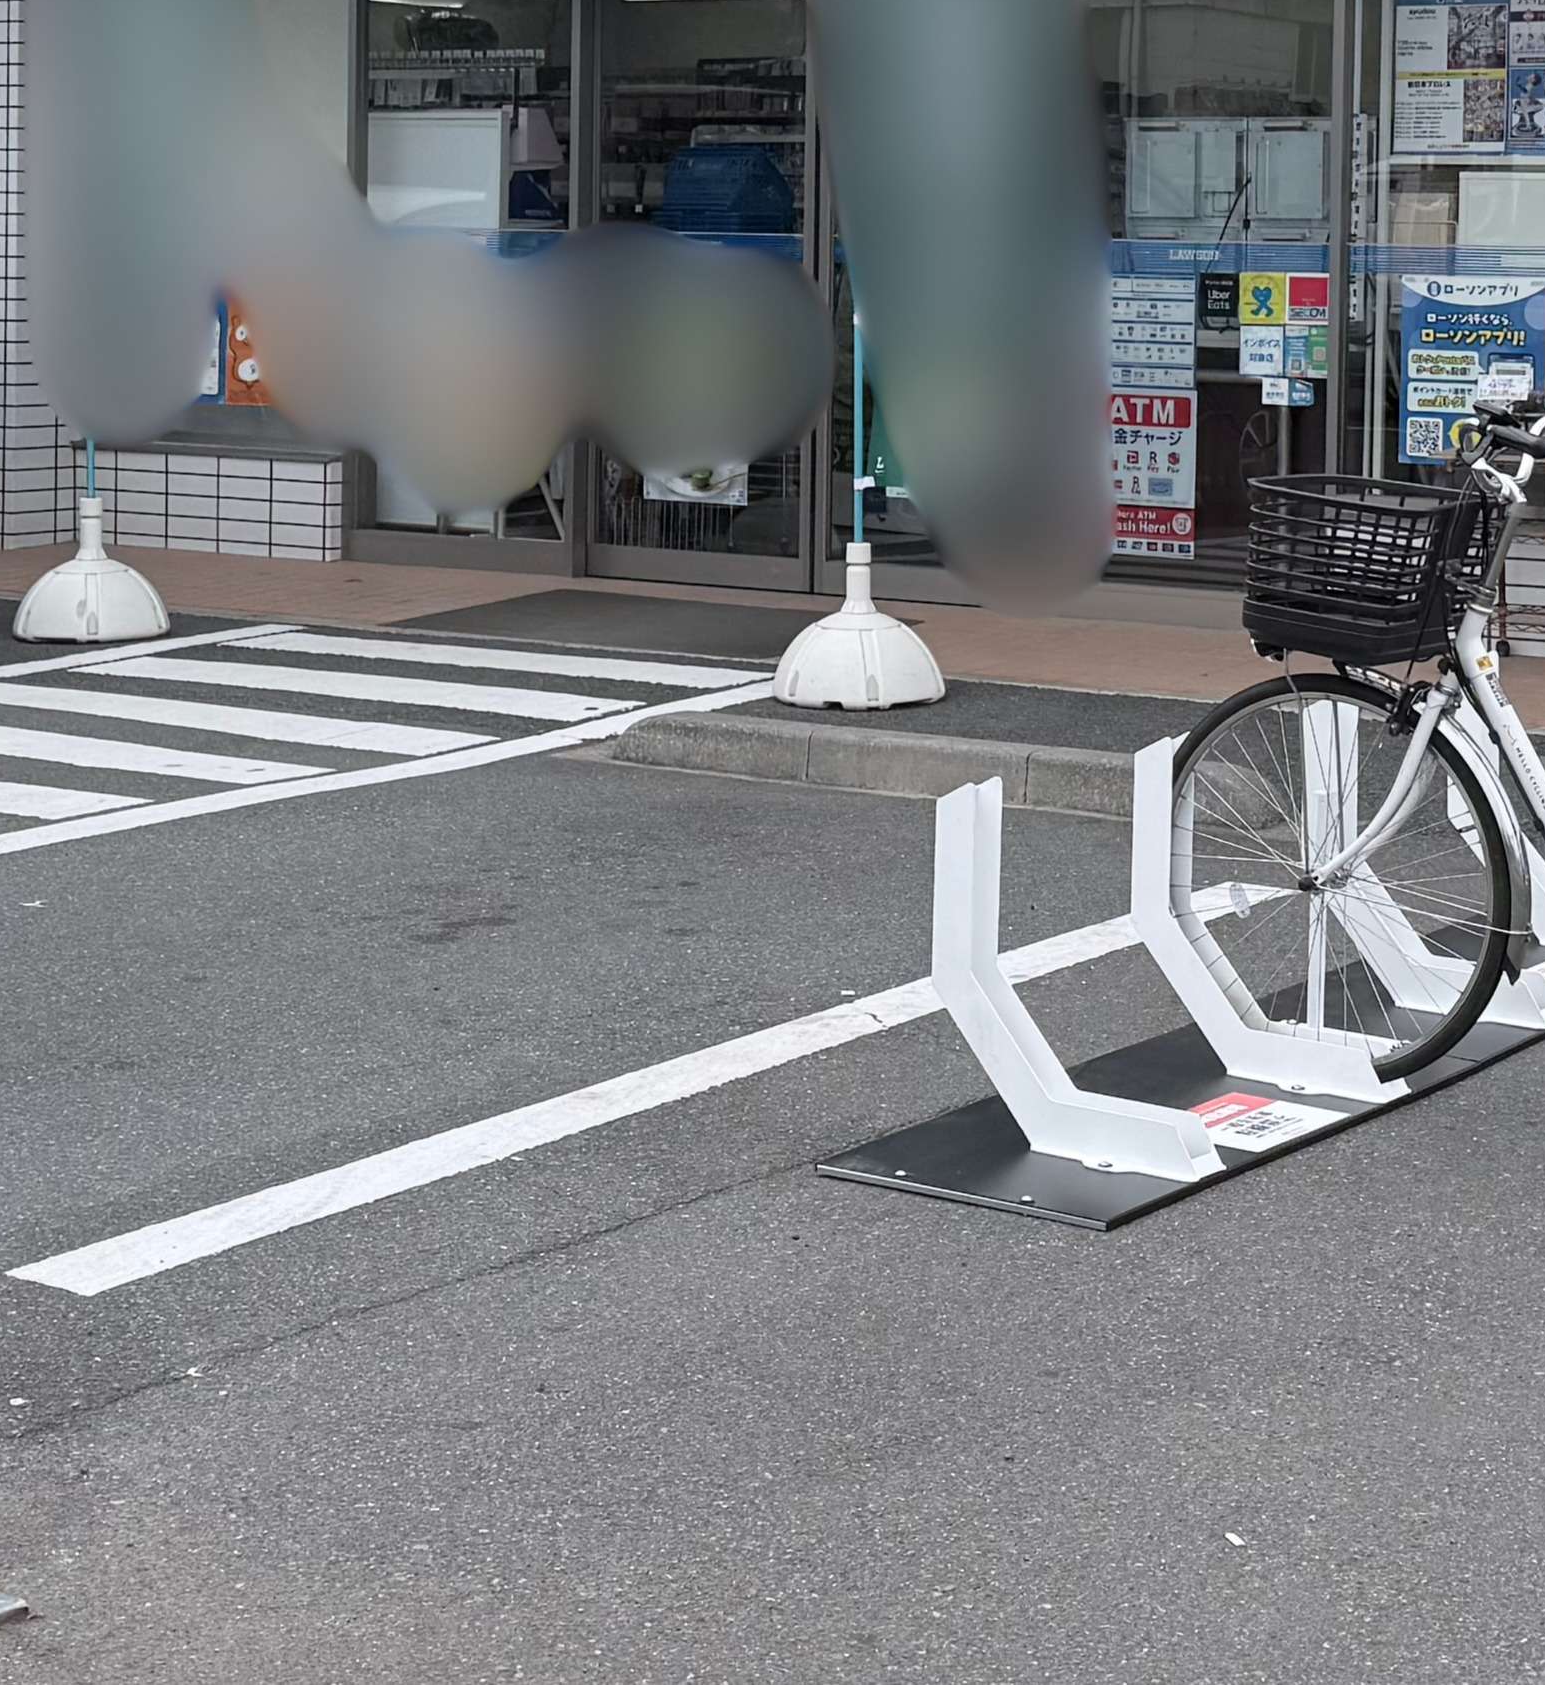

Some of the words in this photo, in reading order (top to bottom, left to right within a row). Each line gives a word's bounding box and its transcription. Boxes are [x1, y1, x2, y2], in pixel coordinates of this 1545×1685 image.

[1169, 249, 1220, 261] LAWSON
[1443, 283, 1519, 297] ローソンアプリ
[1111, 396, 1175, 425] ATM
